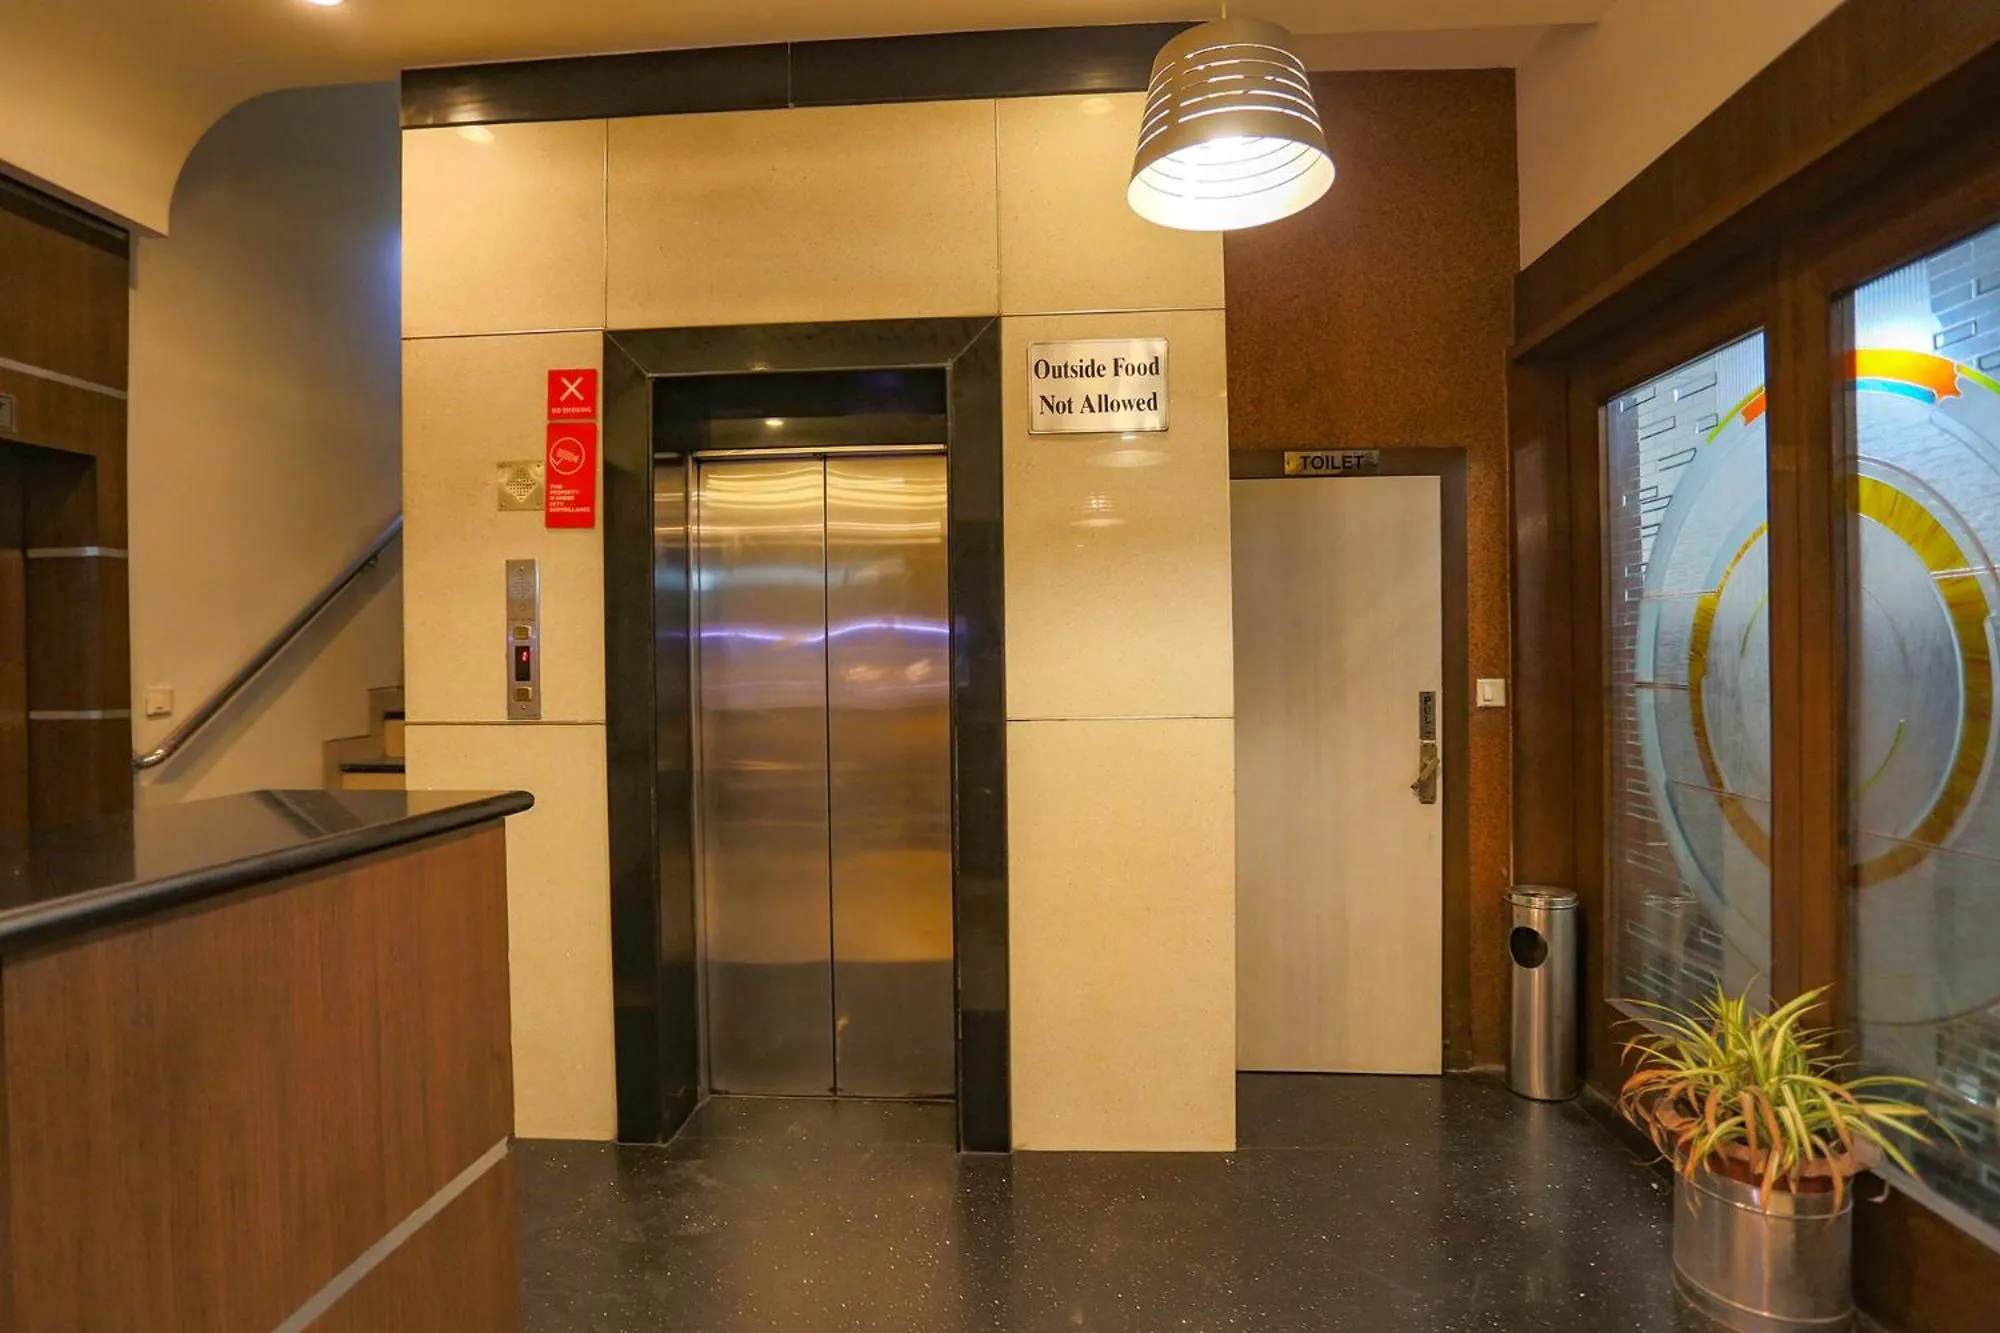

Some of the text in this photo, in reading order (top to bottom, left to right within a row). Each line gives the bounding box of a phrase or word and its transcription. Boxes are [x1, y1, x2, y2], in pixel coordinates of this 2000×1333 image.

[1034, 356, 1160, 379] Outside Food
[1040, 392, 1158, 415] Not Allowed
[1300, 455, 1364, 470] TOILET
